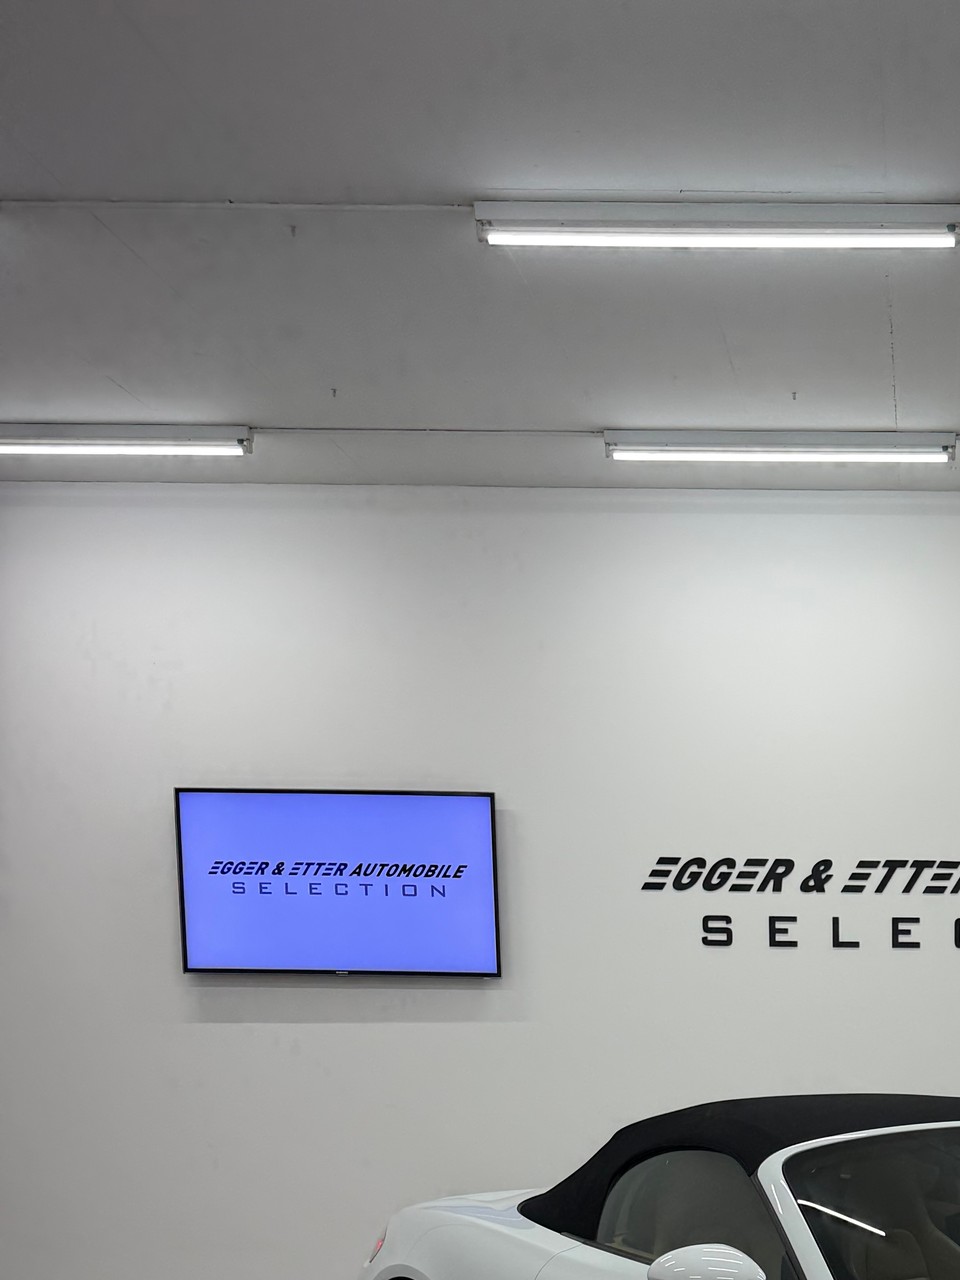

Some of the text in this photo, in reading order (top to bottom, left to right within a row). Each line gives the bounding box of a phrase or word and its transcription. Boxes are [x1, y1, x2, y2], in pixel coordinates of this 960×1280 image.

[208, 861, 467, 879] EGGER & ETTER AUTOMOBILE
[641, 856, 794, 893] EGGER
[800, 858, 833, 893] &
[232, 881, 446, 898] SELECTION
